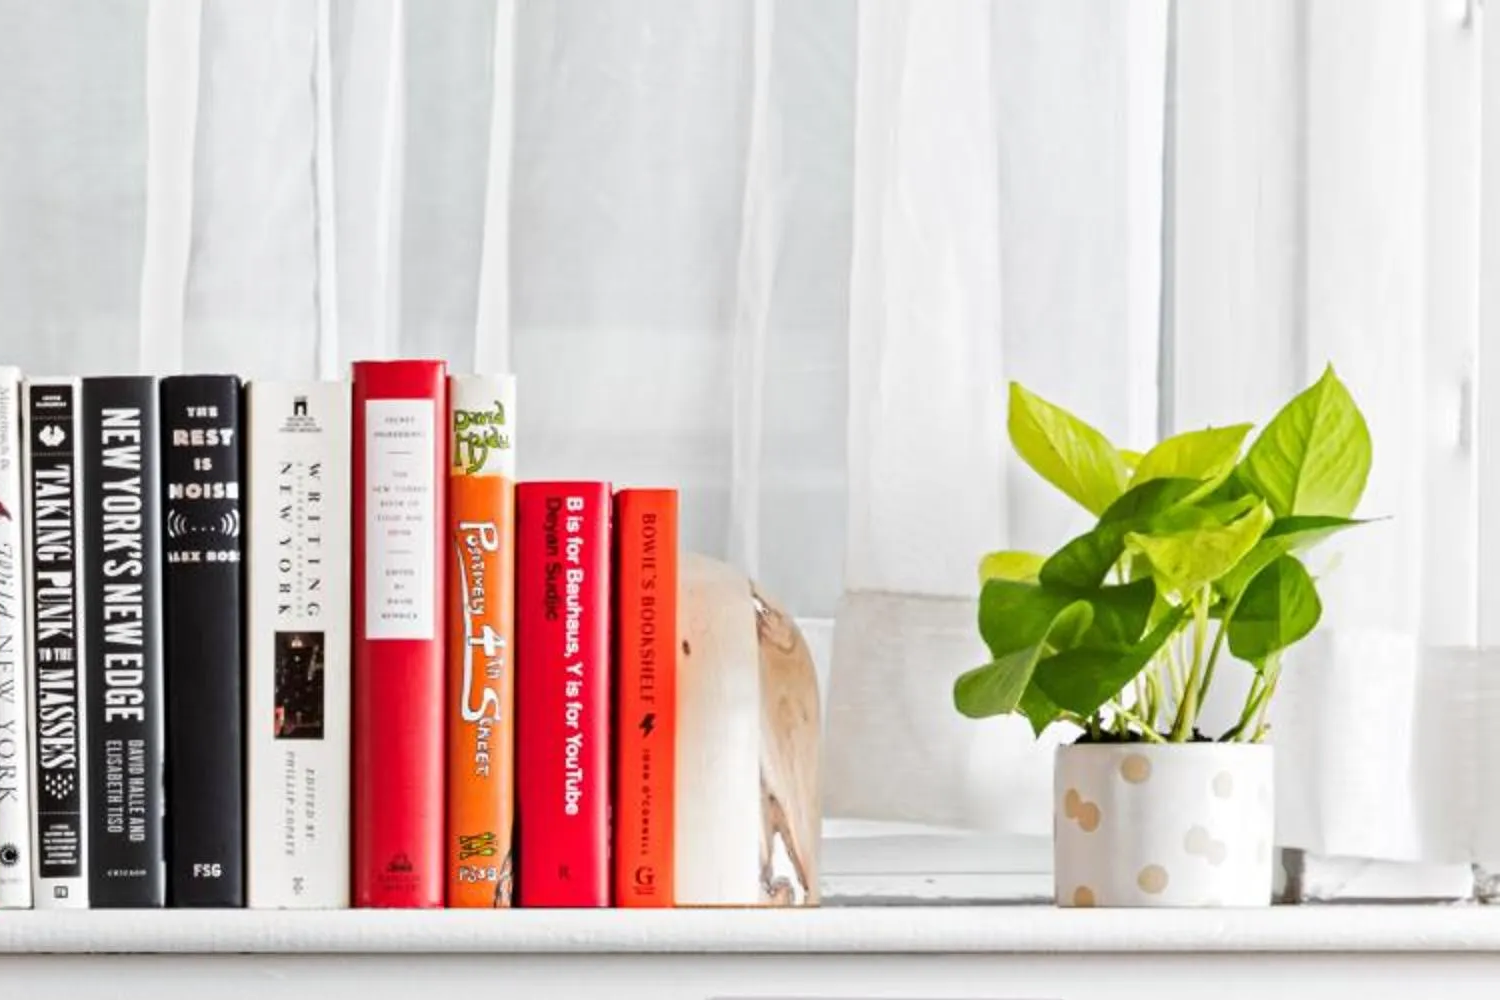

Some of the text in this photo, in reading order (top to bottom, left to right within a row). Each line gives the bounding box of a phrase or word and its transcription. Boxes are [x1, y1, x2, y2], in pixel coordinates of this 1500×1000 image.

[172, 428, 235, 447] REST
[186, 405, 219, 418] THE
[35, 464, 73, 562] TAKING
[168, 482, 240, 500] NOISE
[192, 456, 213, 472] IS
[101, 407, 145, 723] NEW YORK'S NEW EDGE
[278, 461, 293, 616] NEW YORK
[307, 462, 322, 617] WRITING
[543, 497, 562, 622] Deyan Sudjic
[37, 571, 74, 641] PUNK
[639, 513, 657, 705] BOWIE'S BOOKSHELF
[564, 496, 585, 816] B is for Bauhaus, Y is for YouTube
[39, 668, 77, 770] MASSES
[106, 739, 125, 834] ELISABETH TISO
[128, 739, 146, 842] DAVID HALLE AND
[193, 863, 222, 878] FSG
[634, 866, 656, 887] G
